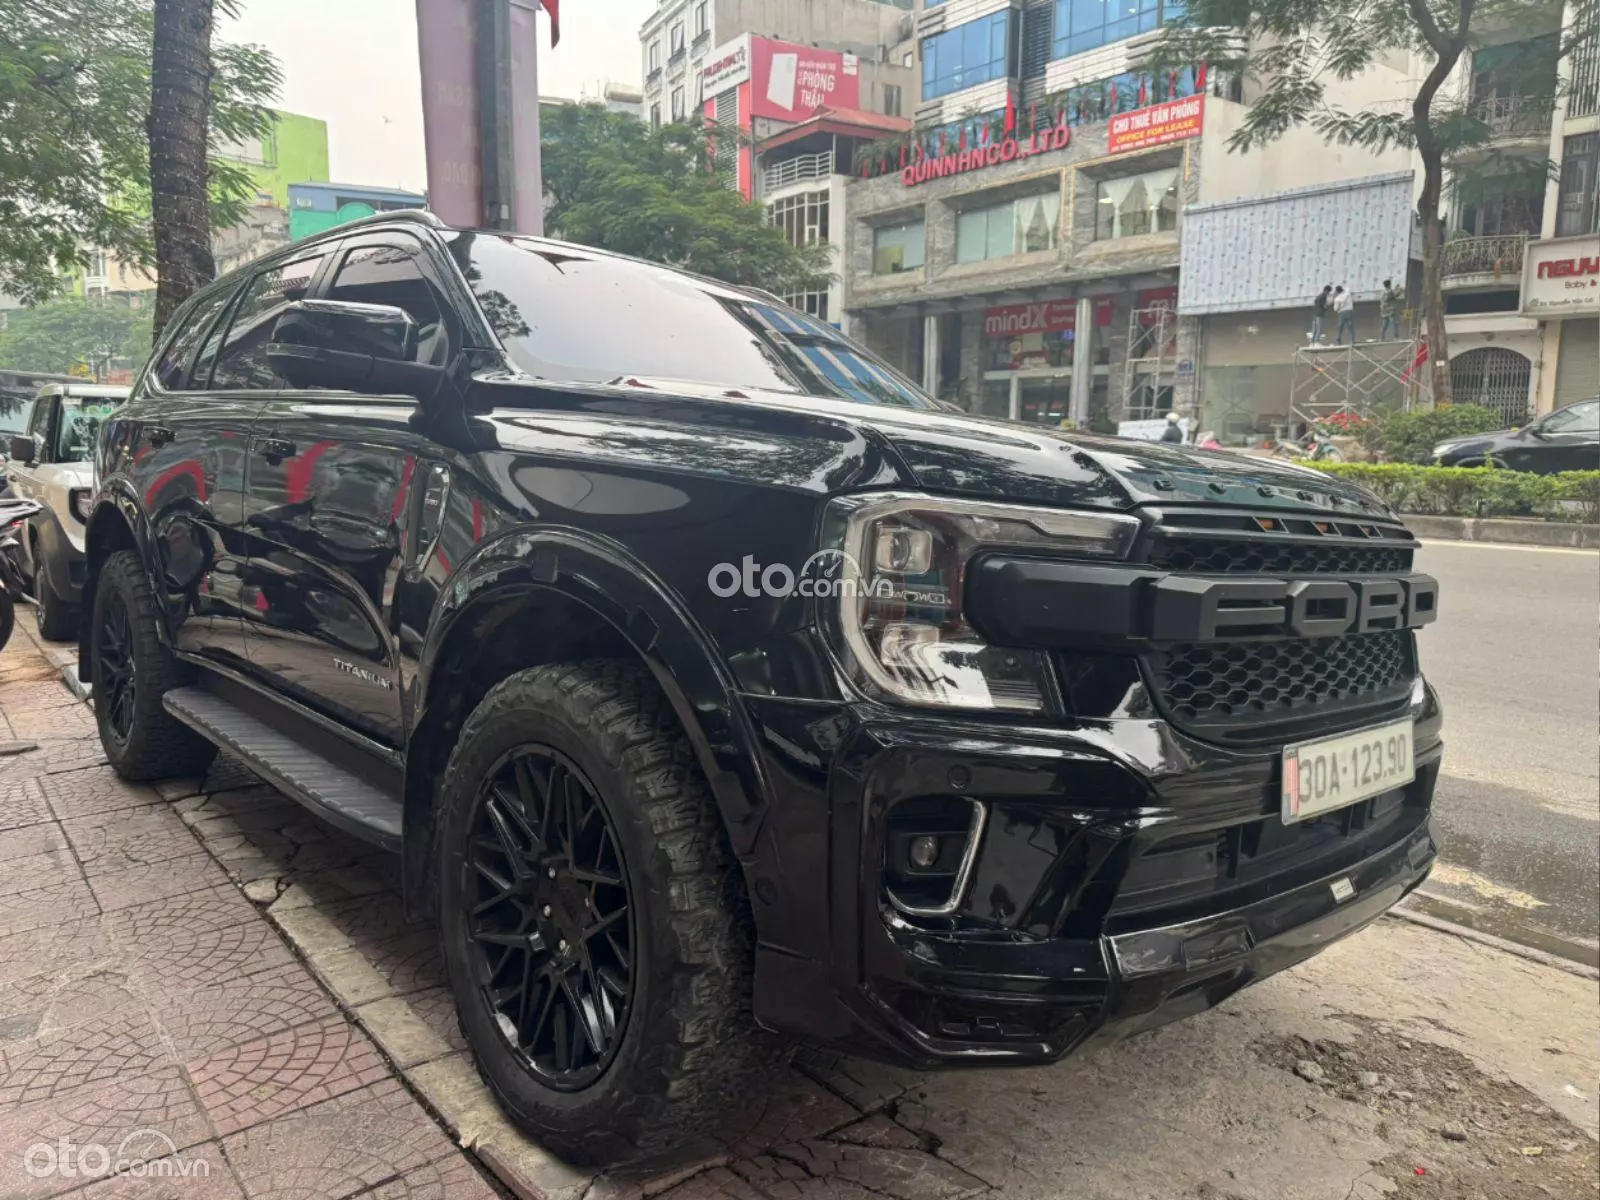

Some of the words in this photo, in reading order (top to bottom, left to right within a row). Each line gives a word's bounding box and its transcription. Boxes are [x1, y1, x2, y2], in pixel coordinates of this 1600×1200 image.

[1112, 119, 1130, 135] CHO
[1170, 99, 1200, 120] PHÒNG
[1116, 130, 1145, 144] OFFICE
[1146, 125, 1165, 137] FOR
[1165, 119, 1195, 133] LEASE
[986, 303, 1048, 333] mindX
[1196, 574, 1438, 640] FORD
[333, 658, 393, 691] TITANIUM
